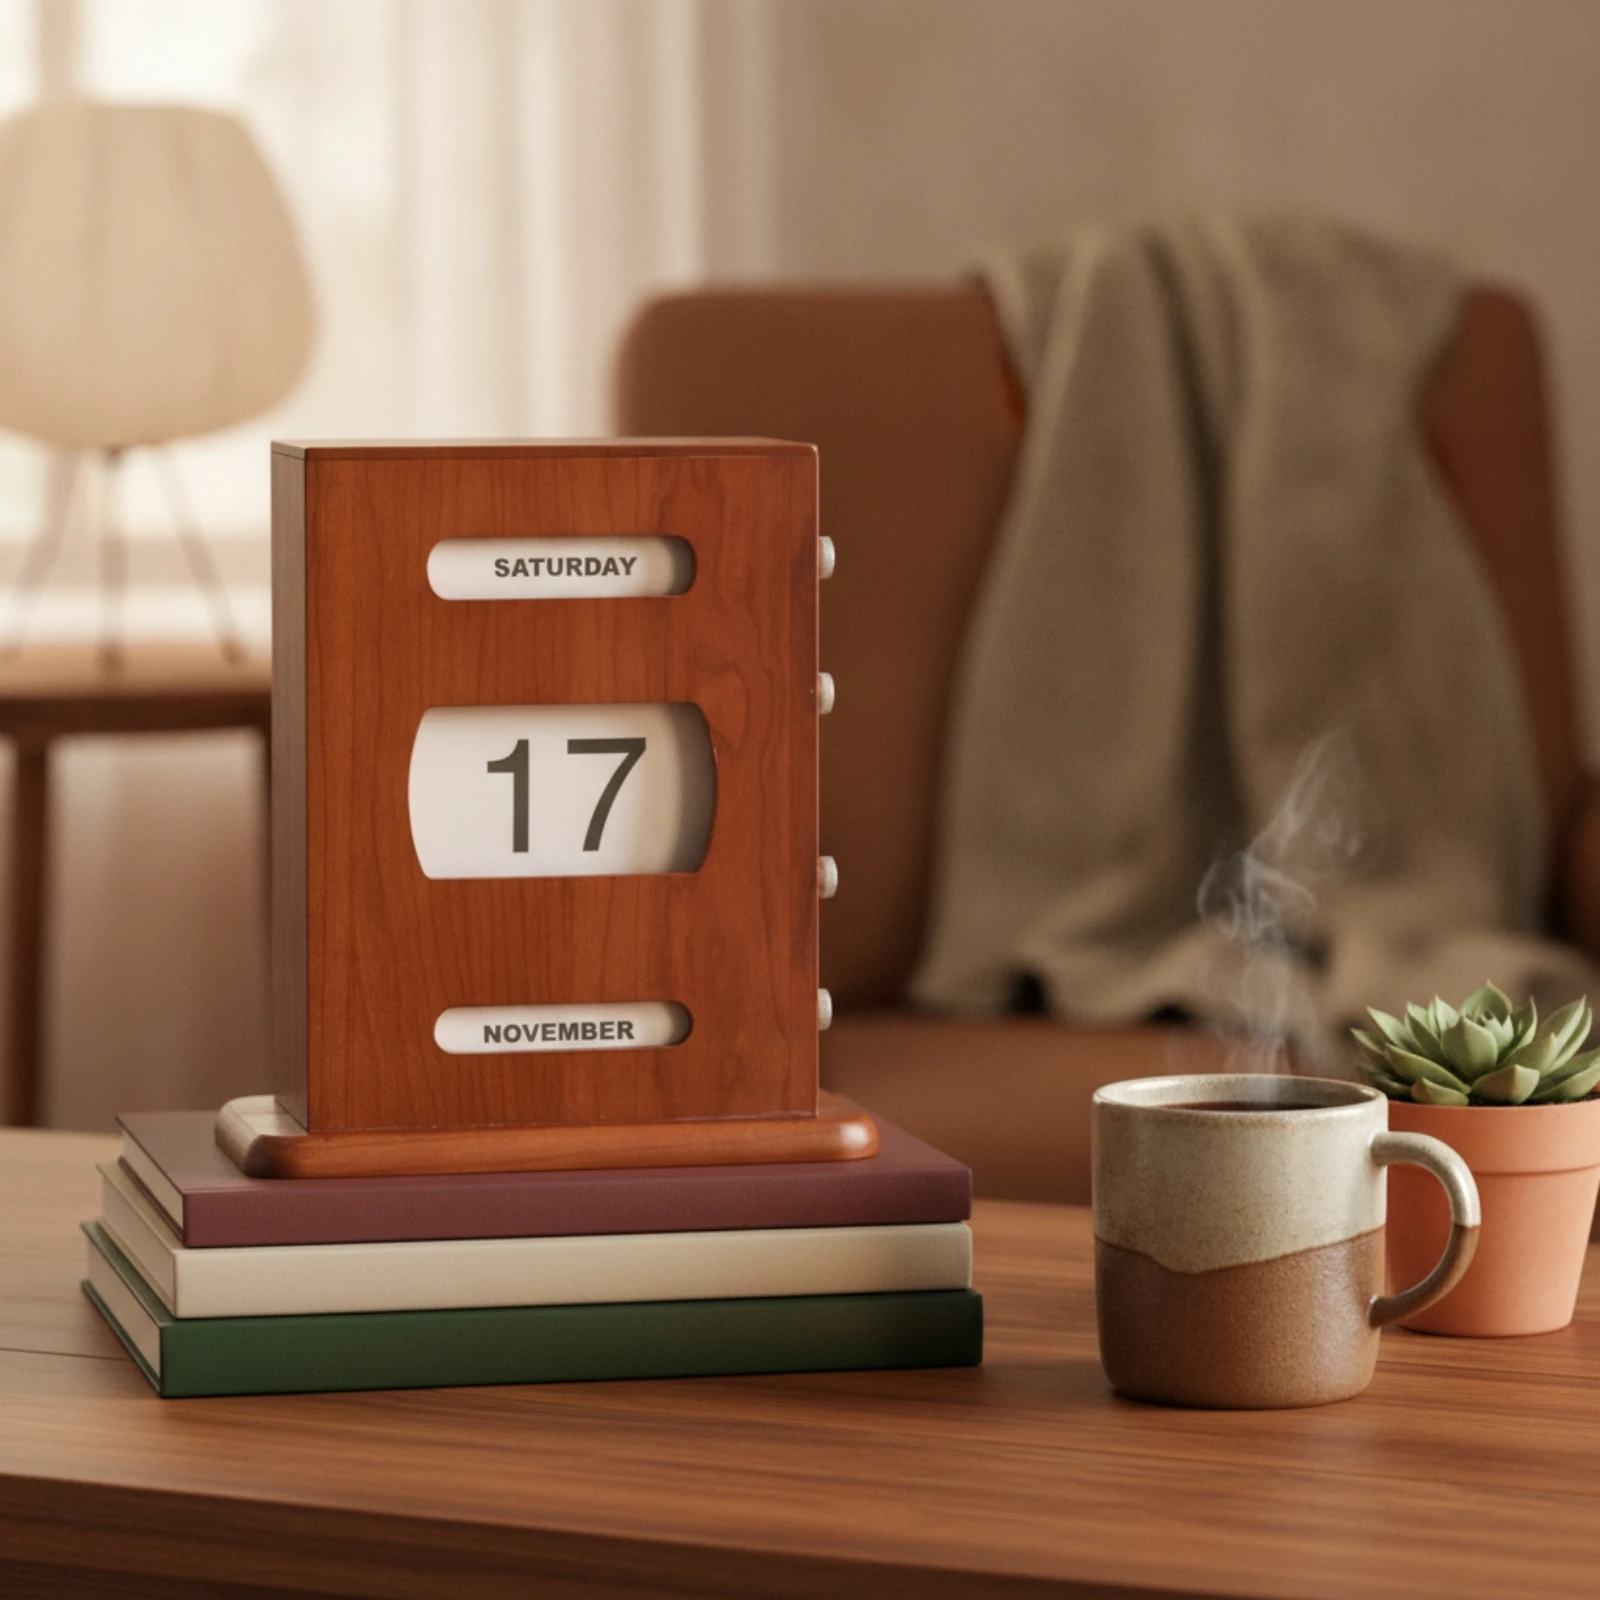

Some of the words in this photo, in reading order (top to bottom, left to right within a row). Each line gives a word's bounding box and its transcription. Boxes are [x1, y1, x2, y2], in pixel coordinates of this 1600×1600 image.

[494, 557, 638, 577] SATURDAY
[486, 736, 647, 853] 17
[483, 1021, 635, 1043] NOVEMBER
